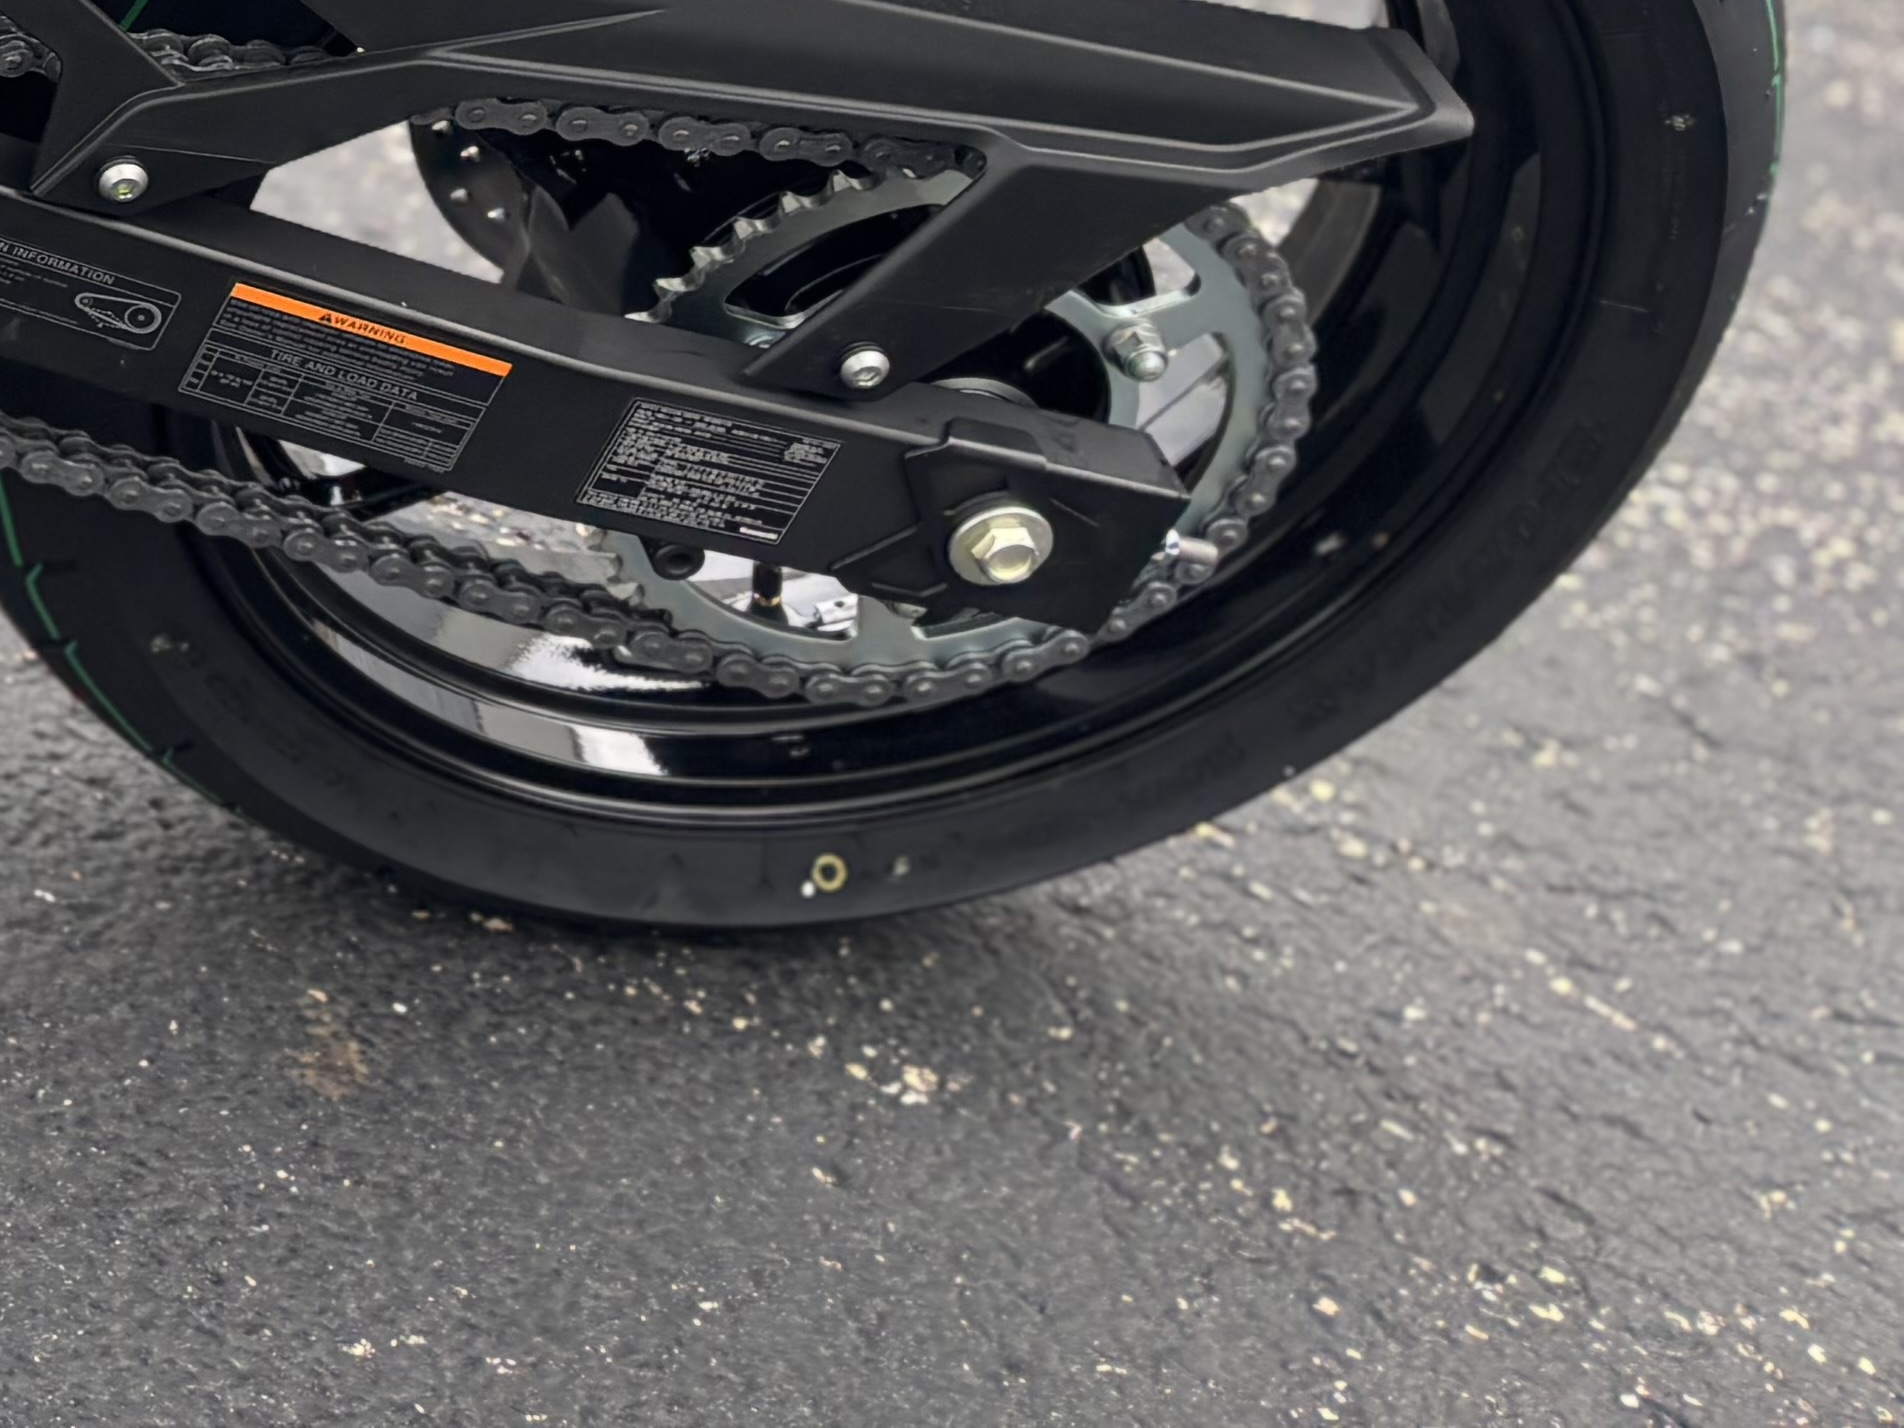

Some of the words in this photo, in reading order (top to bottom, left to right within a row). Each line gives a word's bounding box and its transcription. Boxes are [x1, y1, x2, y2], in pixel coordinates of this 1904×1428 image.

[12, 246, 116, 286] INFORMATION
[334, 313, 408, 345] WARNING
[270, 349, 303, 368] TIRE
[304, 361, 336, 376] AND
[337, 370, 378, 389] LOAD
[379, 381, 419, 401] DATA
